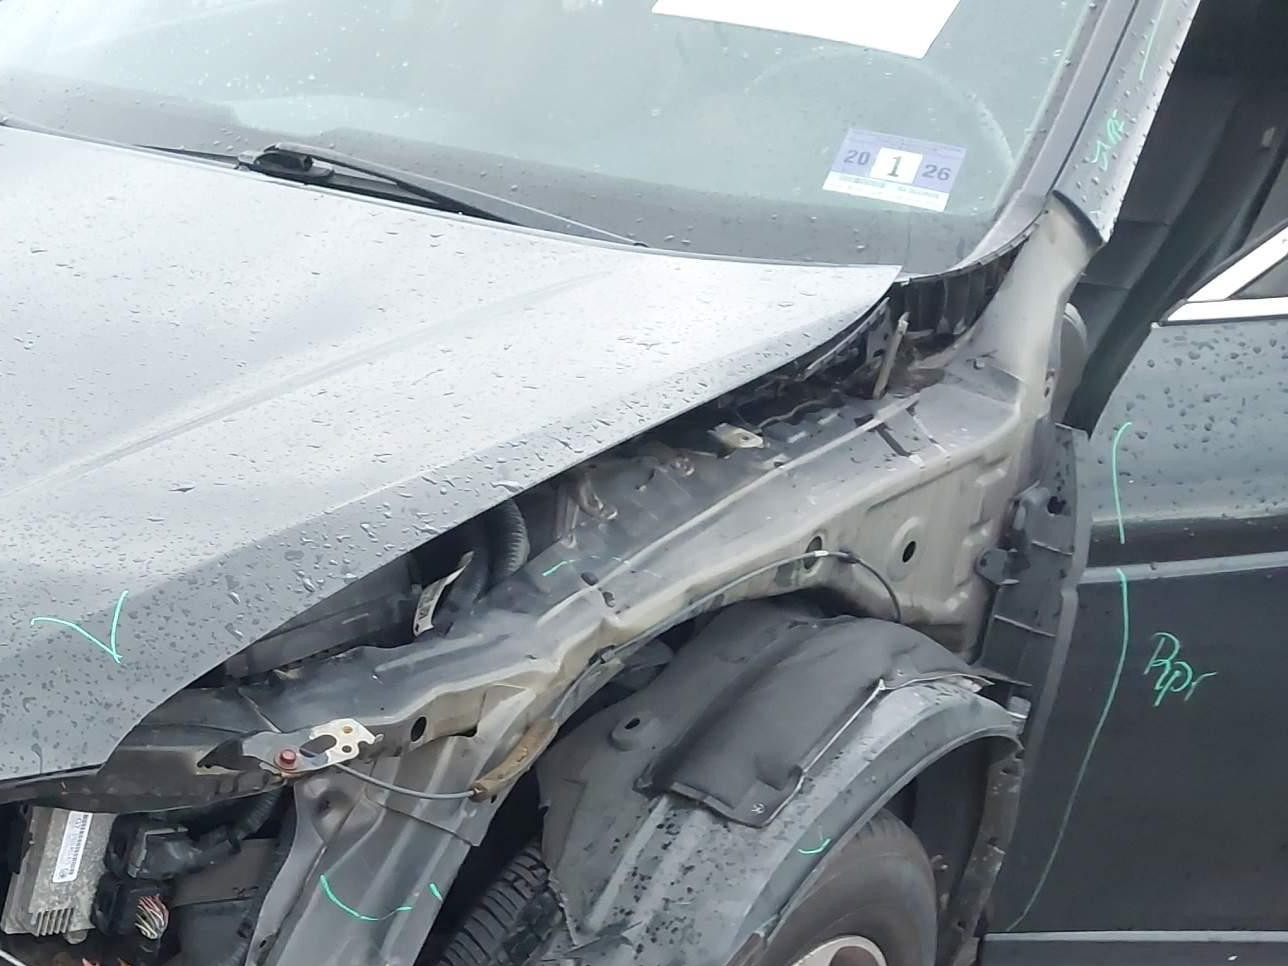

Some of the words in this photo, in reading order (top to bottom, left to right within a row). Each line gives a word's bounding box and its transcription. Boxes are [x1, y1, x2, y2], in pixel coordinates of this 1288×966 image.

[843, 149, 871, 166] 20
[887, 155, 902, 178] 1
[921, 164, 951, 181] 26
